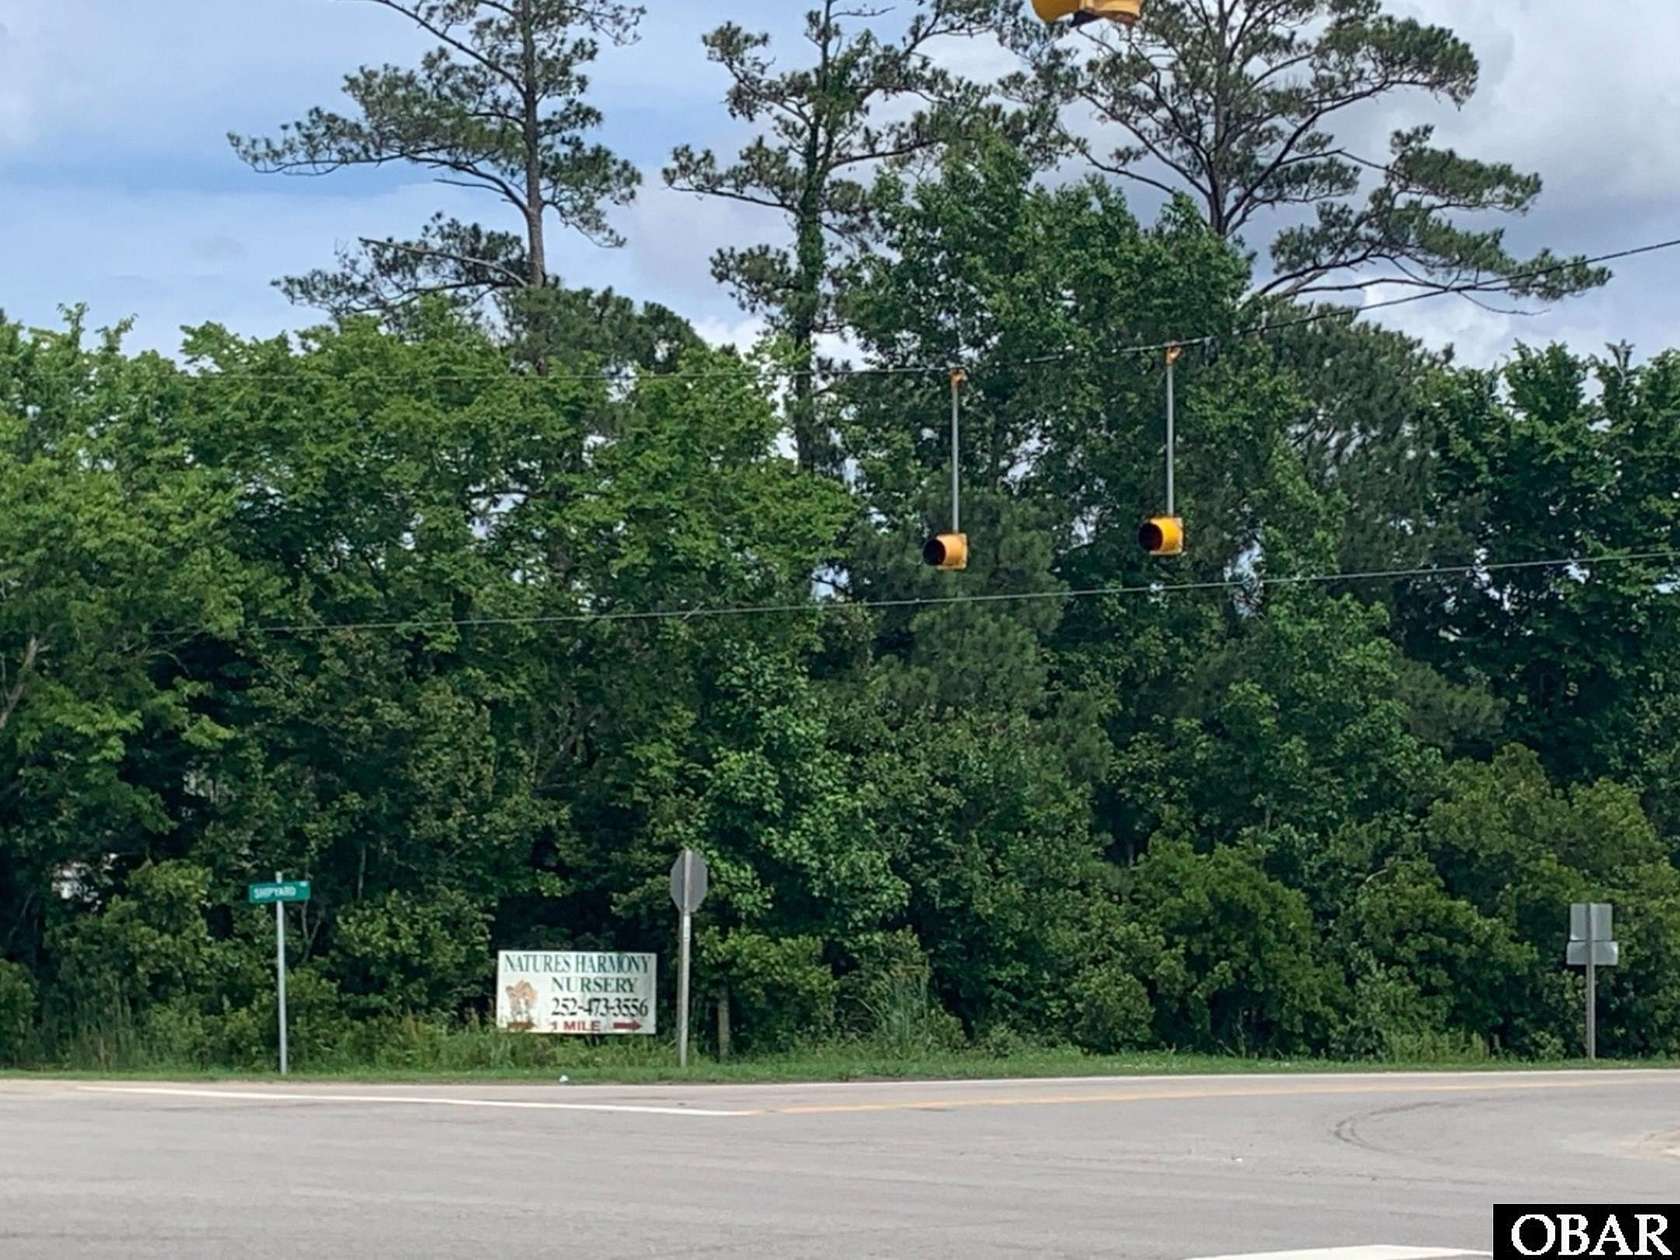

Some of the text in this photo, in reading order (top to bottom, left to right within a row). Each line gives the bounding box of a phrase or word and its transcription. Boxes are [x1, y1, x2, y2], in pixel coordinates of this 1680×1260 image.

[254, 886, 296, 899] SHIPYARD
[504, 954, 651, 974] NATURES HARMONY
[552, 976, 638, 993] NURSERY
[551, 997, 649, 1017] 252-473-3556
[551, 1020, 601, 1031] 1 MILE
